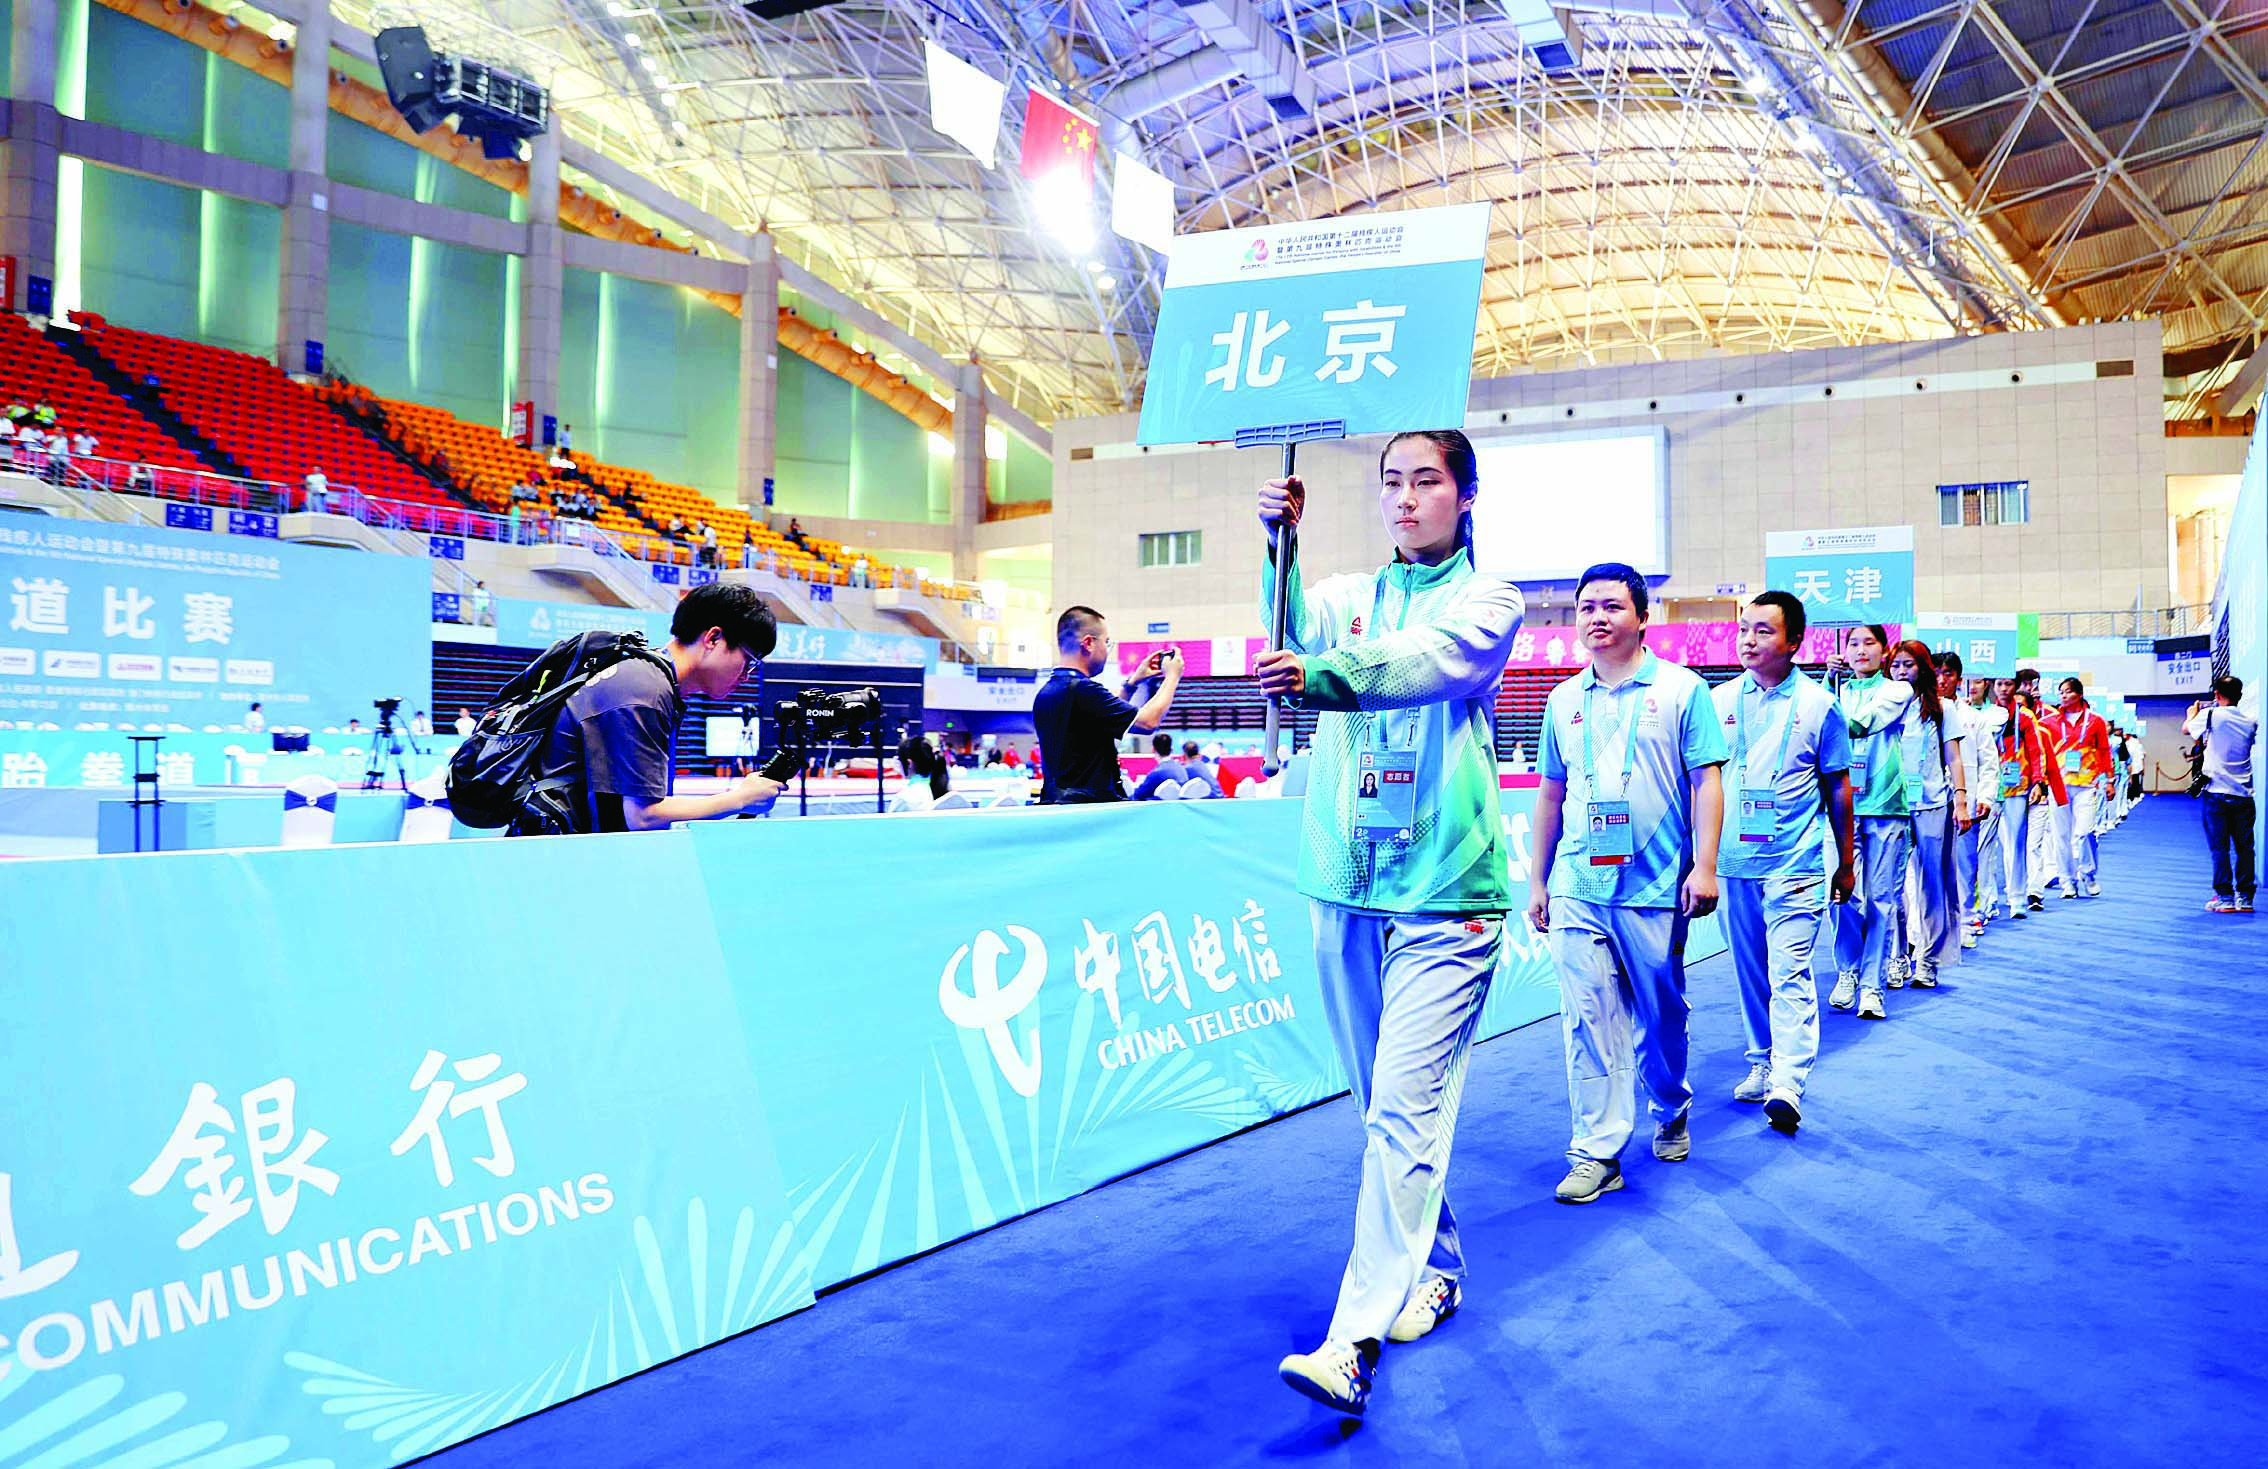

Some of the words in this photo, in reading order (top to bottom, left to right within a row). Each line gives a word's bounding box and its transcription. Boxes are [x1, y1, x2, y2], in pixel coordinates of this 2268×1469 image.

[1205, 299, 1407, 391] 北京
[9, 577, 234, 645] 道比赛
[1793, 566, 1883, 604] 天津
[2168, 661, 2200, 674] 安全出口
[2175, 676, 2193, 685] EXIT
[806, 709, 834, 717] RONIN
[2, 751, 196, 789] 跆拳道
[1074, 898, 1282, 1030] 中国电信
[1098, 1025, 1187, 1071] CHINA
[1185, 993, 1296, 1047] TELECOM
[0, 1171, 615, 1380] OMMUNICATIONS
